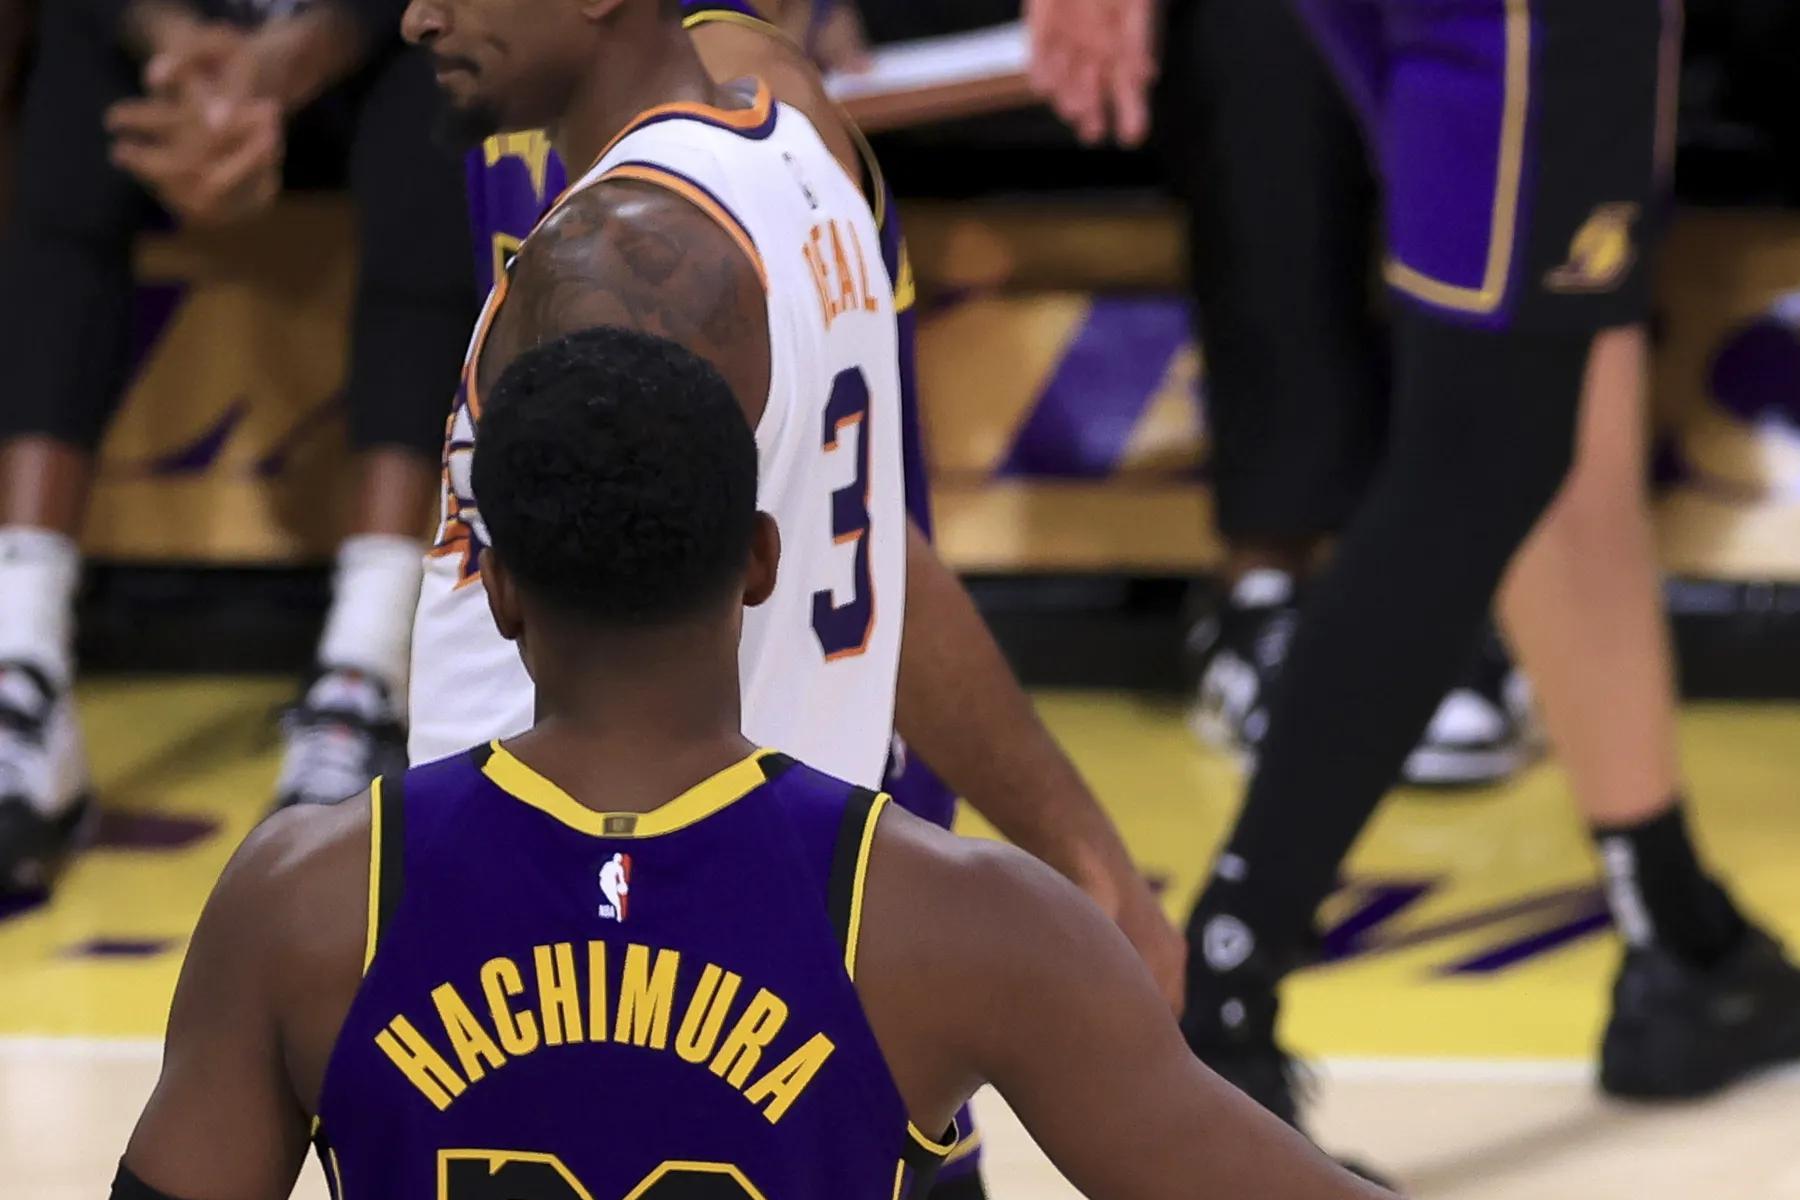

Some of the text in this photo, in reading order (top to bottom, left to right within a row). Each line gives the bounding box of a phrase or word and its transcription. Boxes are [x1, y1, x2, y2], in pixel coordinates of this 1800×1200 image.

[803, 218, 878, 332] EAL
[810, 365, 876, 663] 3
[374, 940, 835, 1125] HACHIMURA
